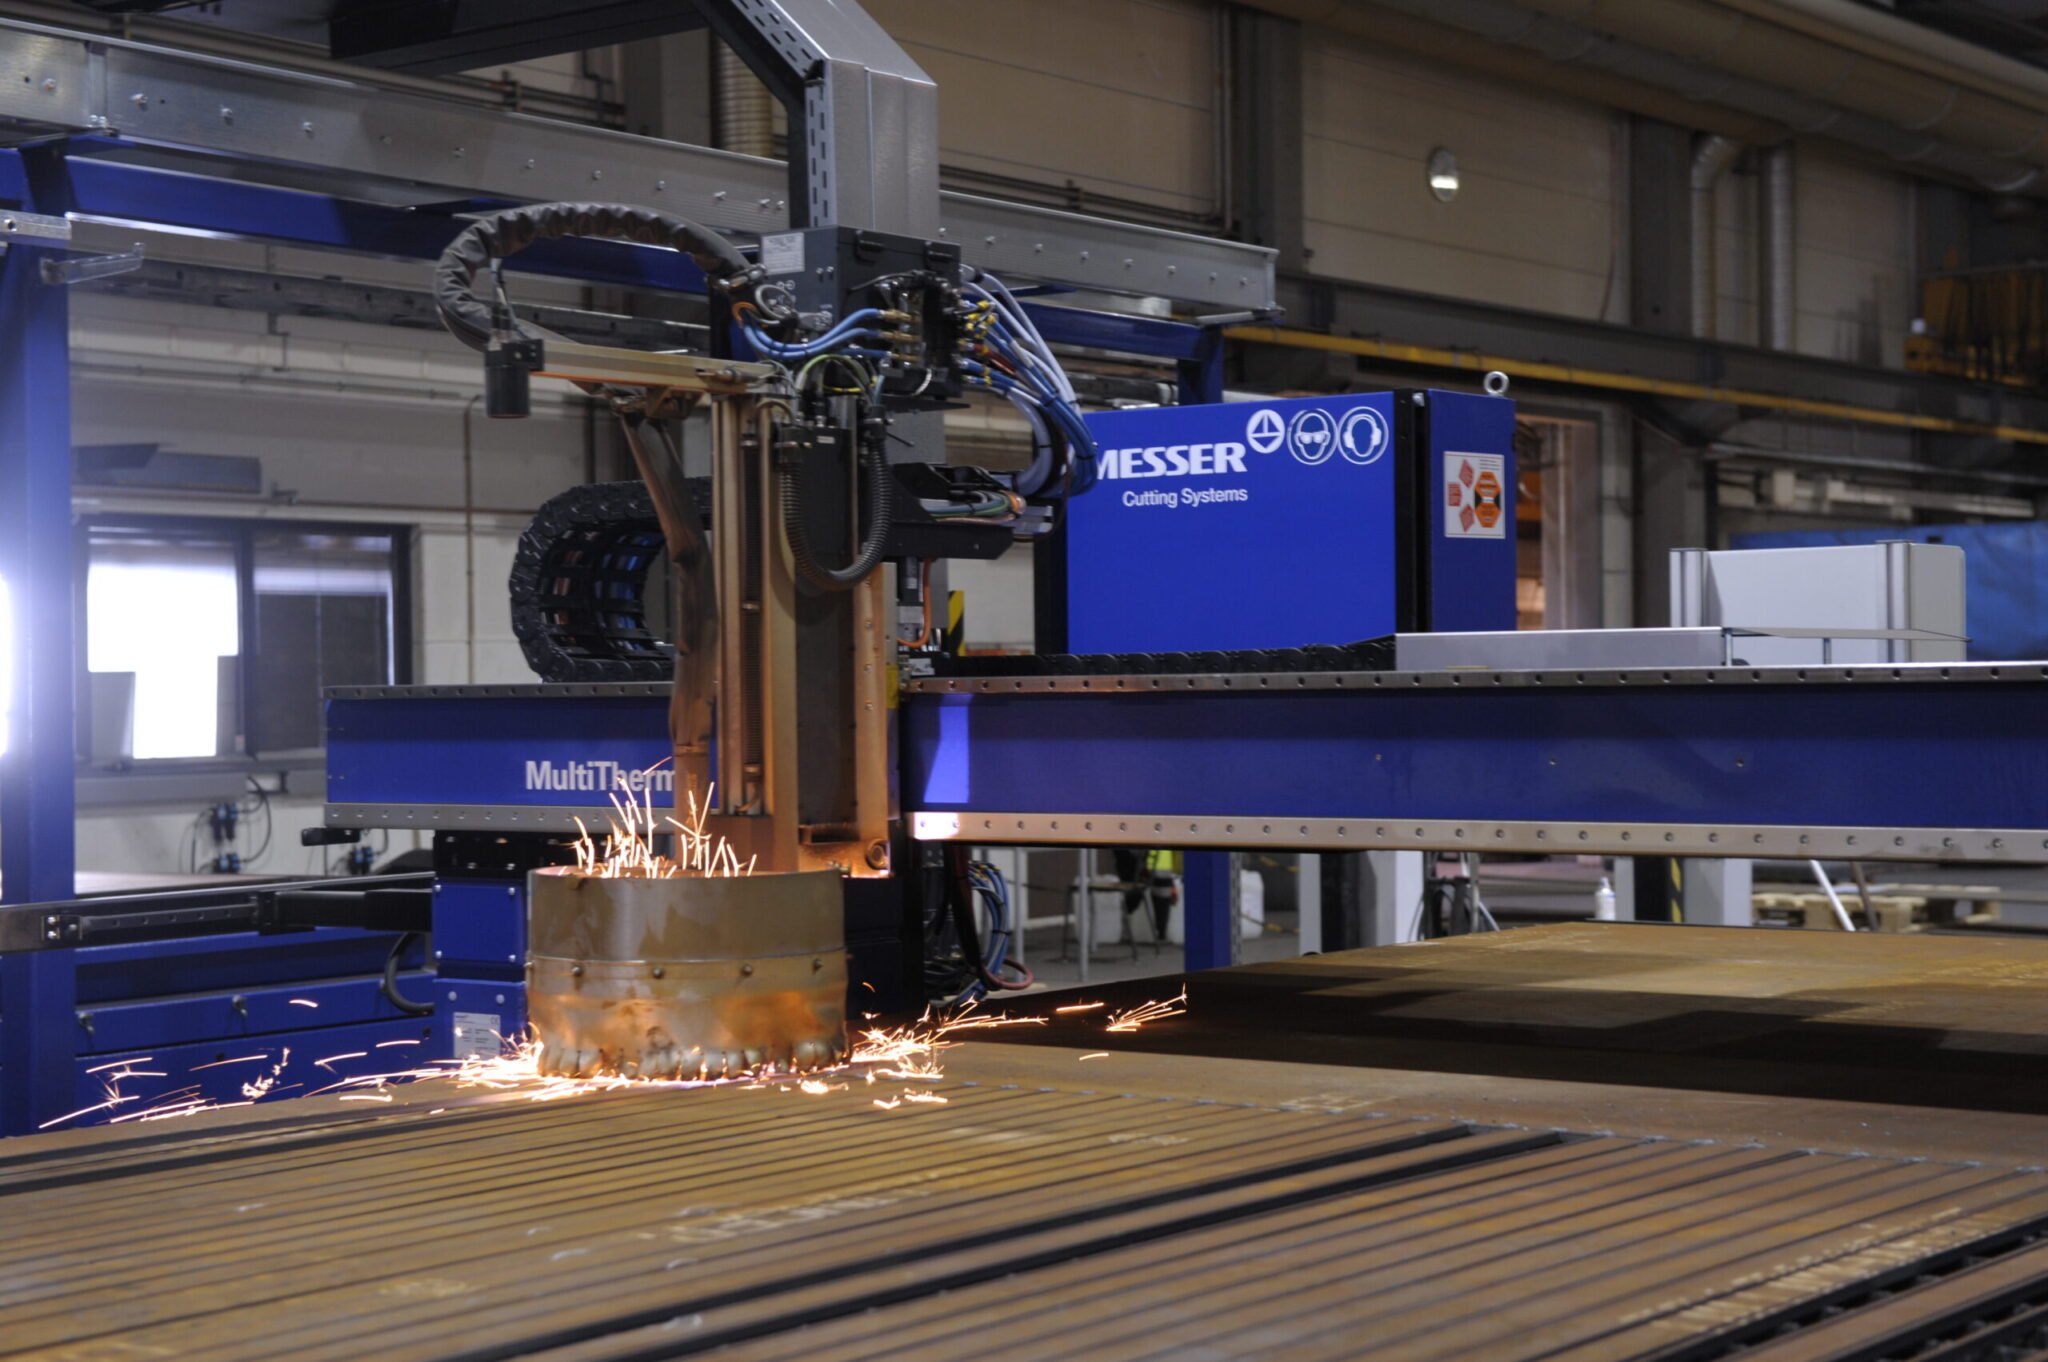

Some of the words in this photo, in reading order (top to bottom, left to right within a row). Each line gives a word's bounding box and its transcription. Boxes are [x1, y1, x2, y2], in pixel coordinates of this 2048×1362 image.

[1122, 490, 1178, 508] Cutting
[1181, 488, 1248, 507] Systems
[526, 760, 675, 792] MultiTherm
